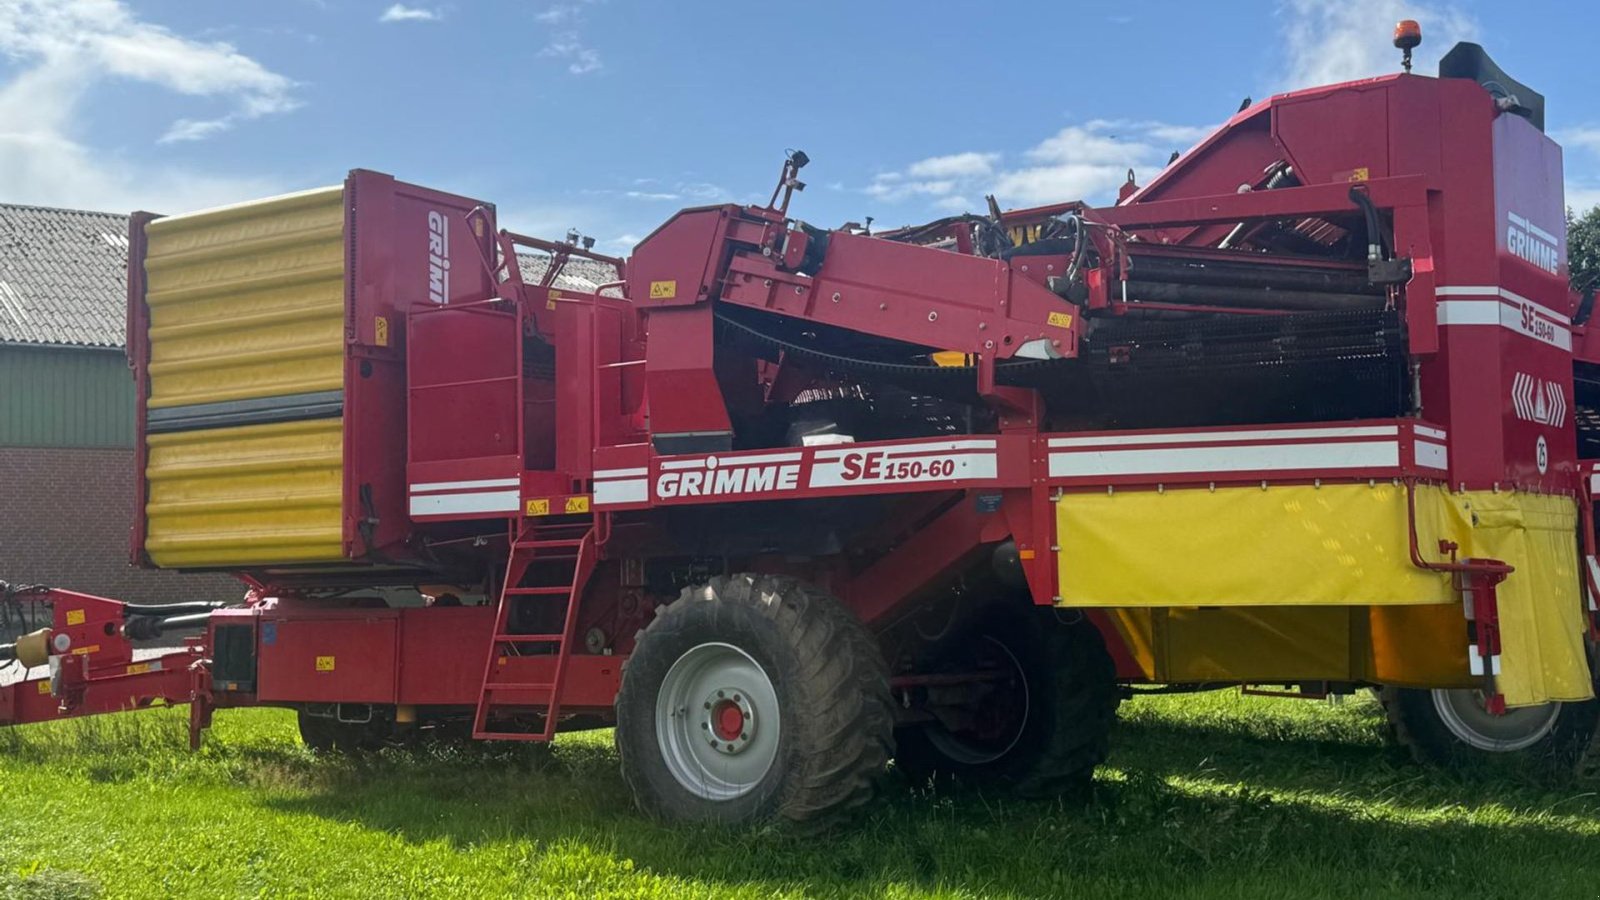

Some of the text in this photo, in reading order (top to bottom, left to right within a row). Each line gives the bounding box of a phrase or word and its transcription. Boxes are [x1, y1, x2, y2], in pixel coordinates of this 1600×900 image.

[1507, 218, 1558, 276] GRIMME
[1521, 302, 1555, 342] SE 150-60
[840, 452, 955, 481] SE 150-60
[1538, 442, 1546, 468] 25
[656, 455, 801, 498] GRIMME
